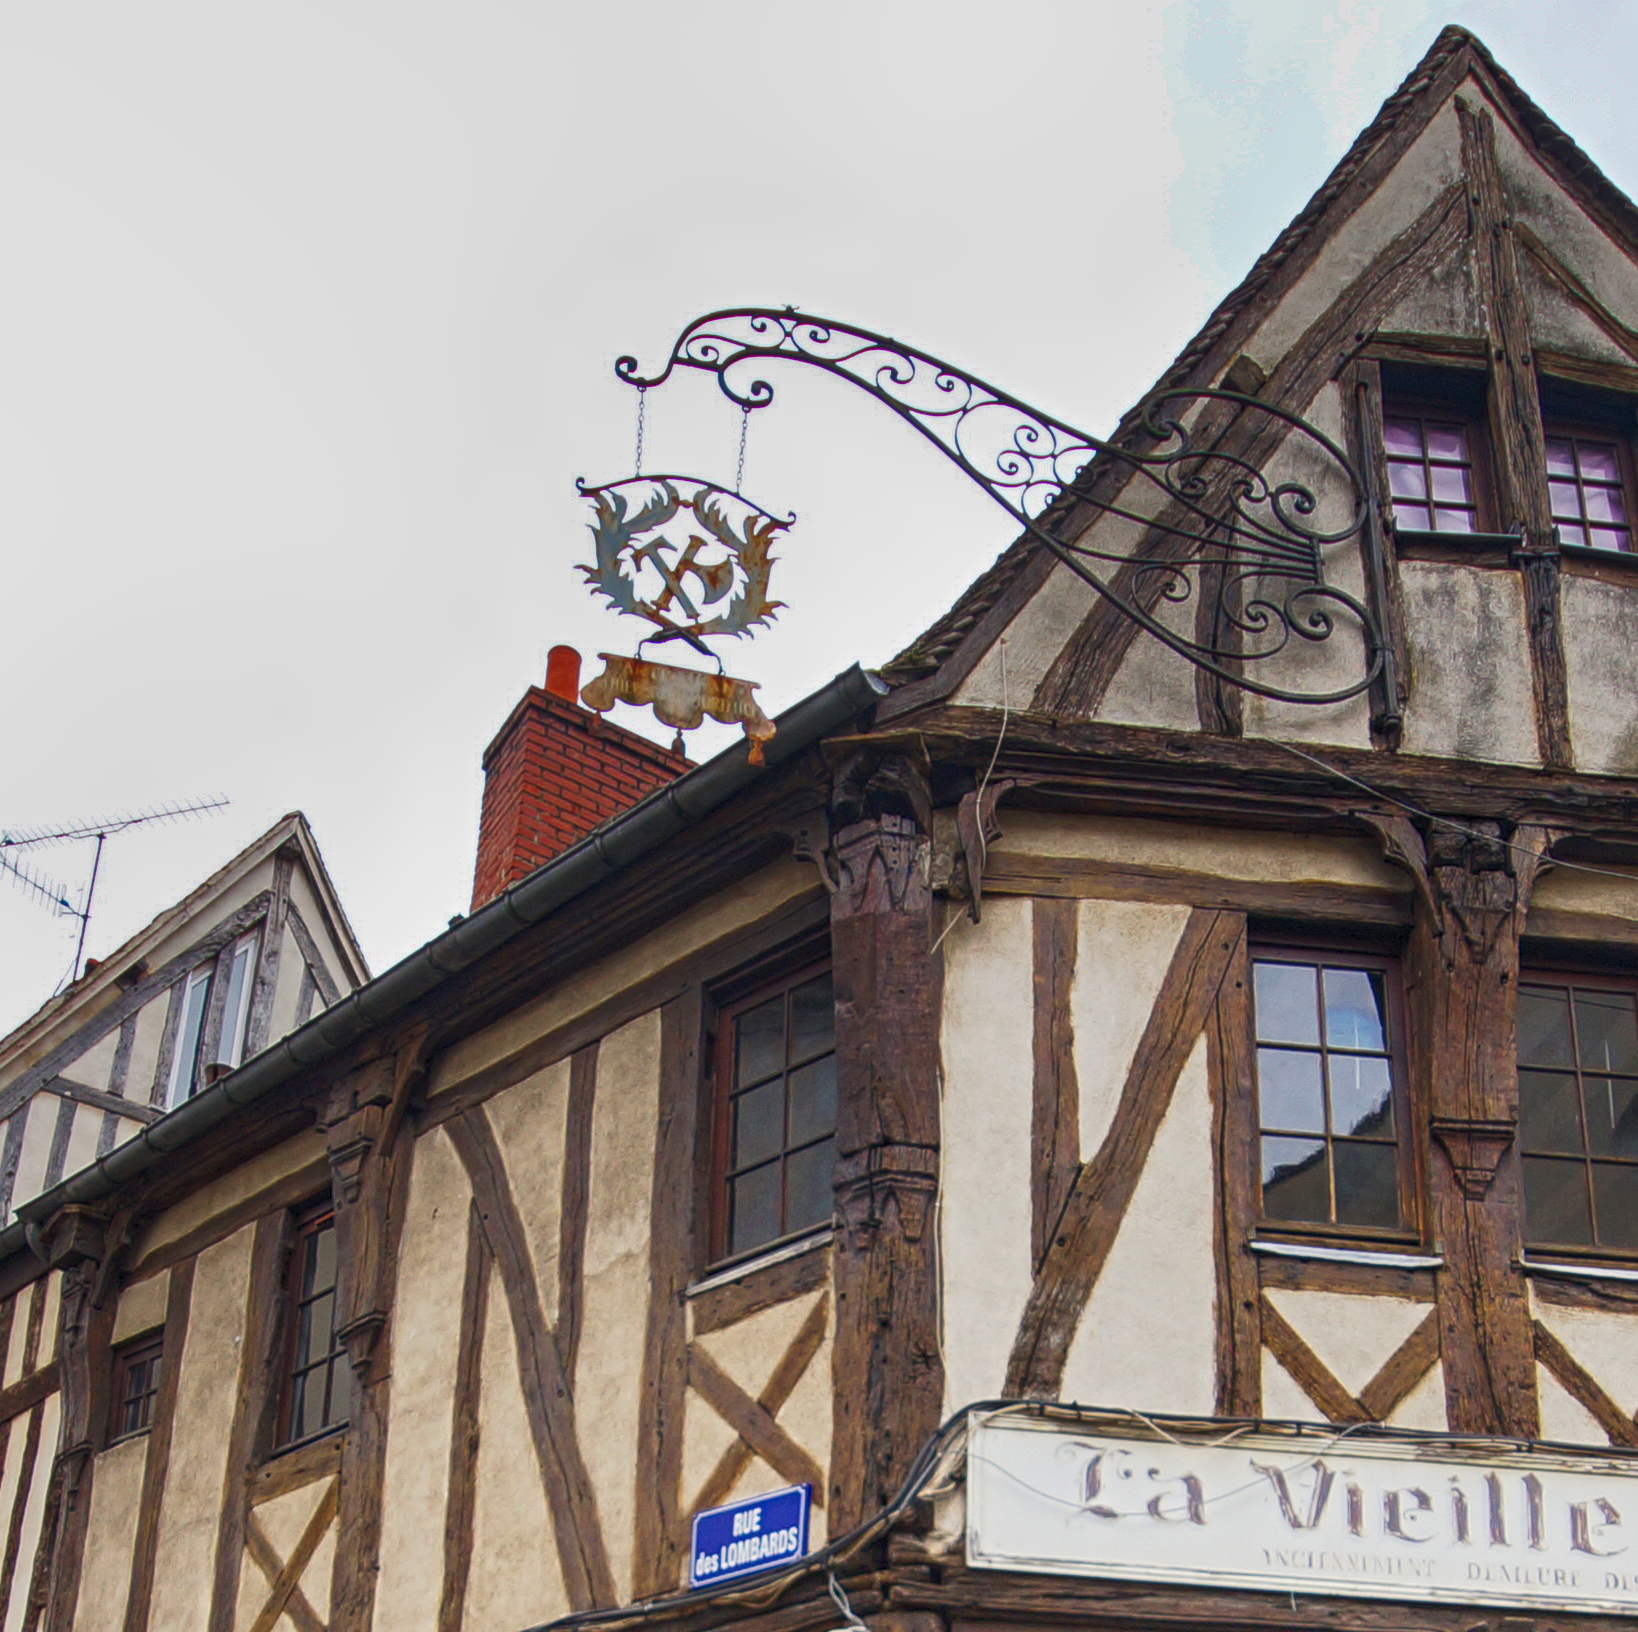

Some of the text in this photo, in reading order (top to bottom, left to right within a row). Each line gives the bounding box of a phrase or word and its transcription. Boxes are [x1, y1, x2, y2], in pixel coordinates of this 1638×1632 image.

[732, 1507, 762, 1537] RUE
[1056, 1441, 1208, 1526] La
[1249, 1457, 1630, 1557] Vieille
[695, 1526, 799, 1576] des LOMBARDS
